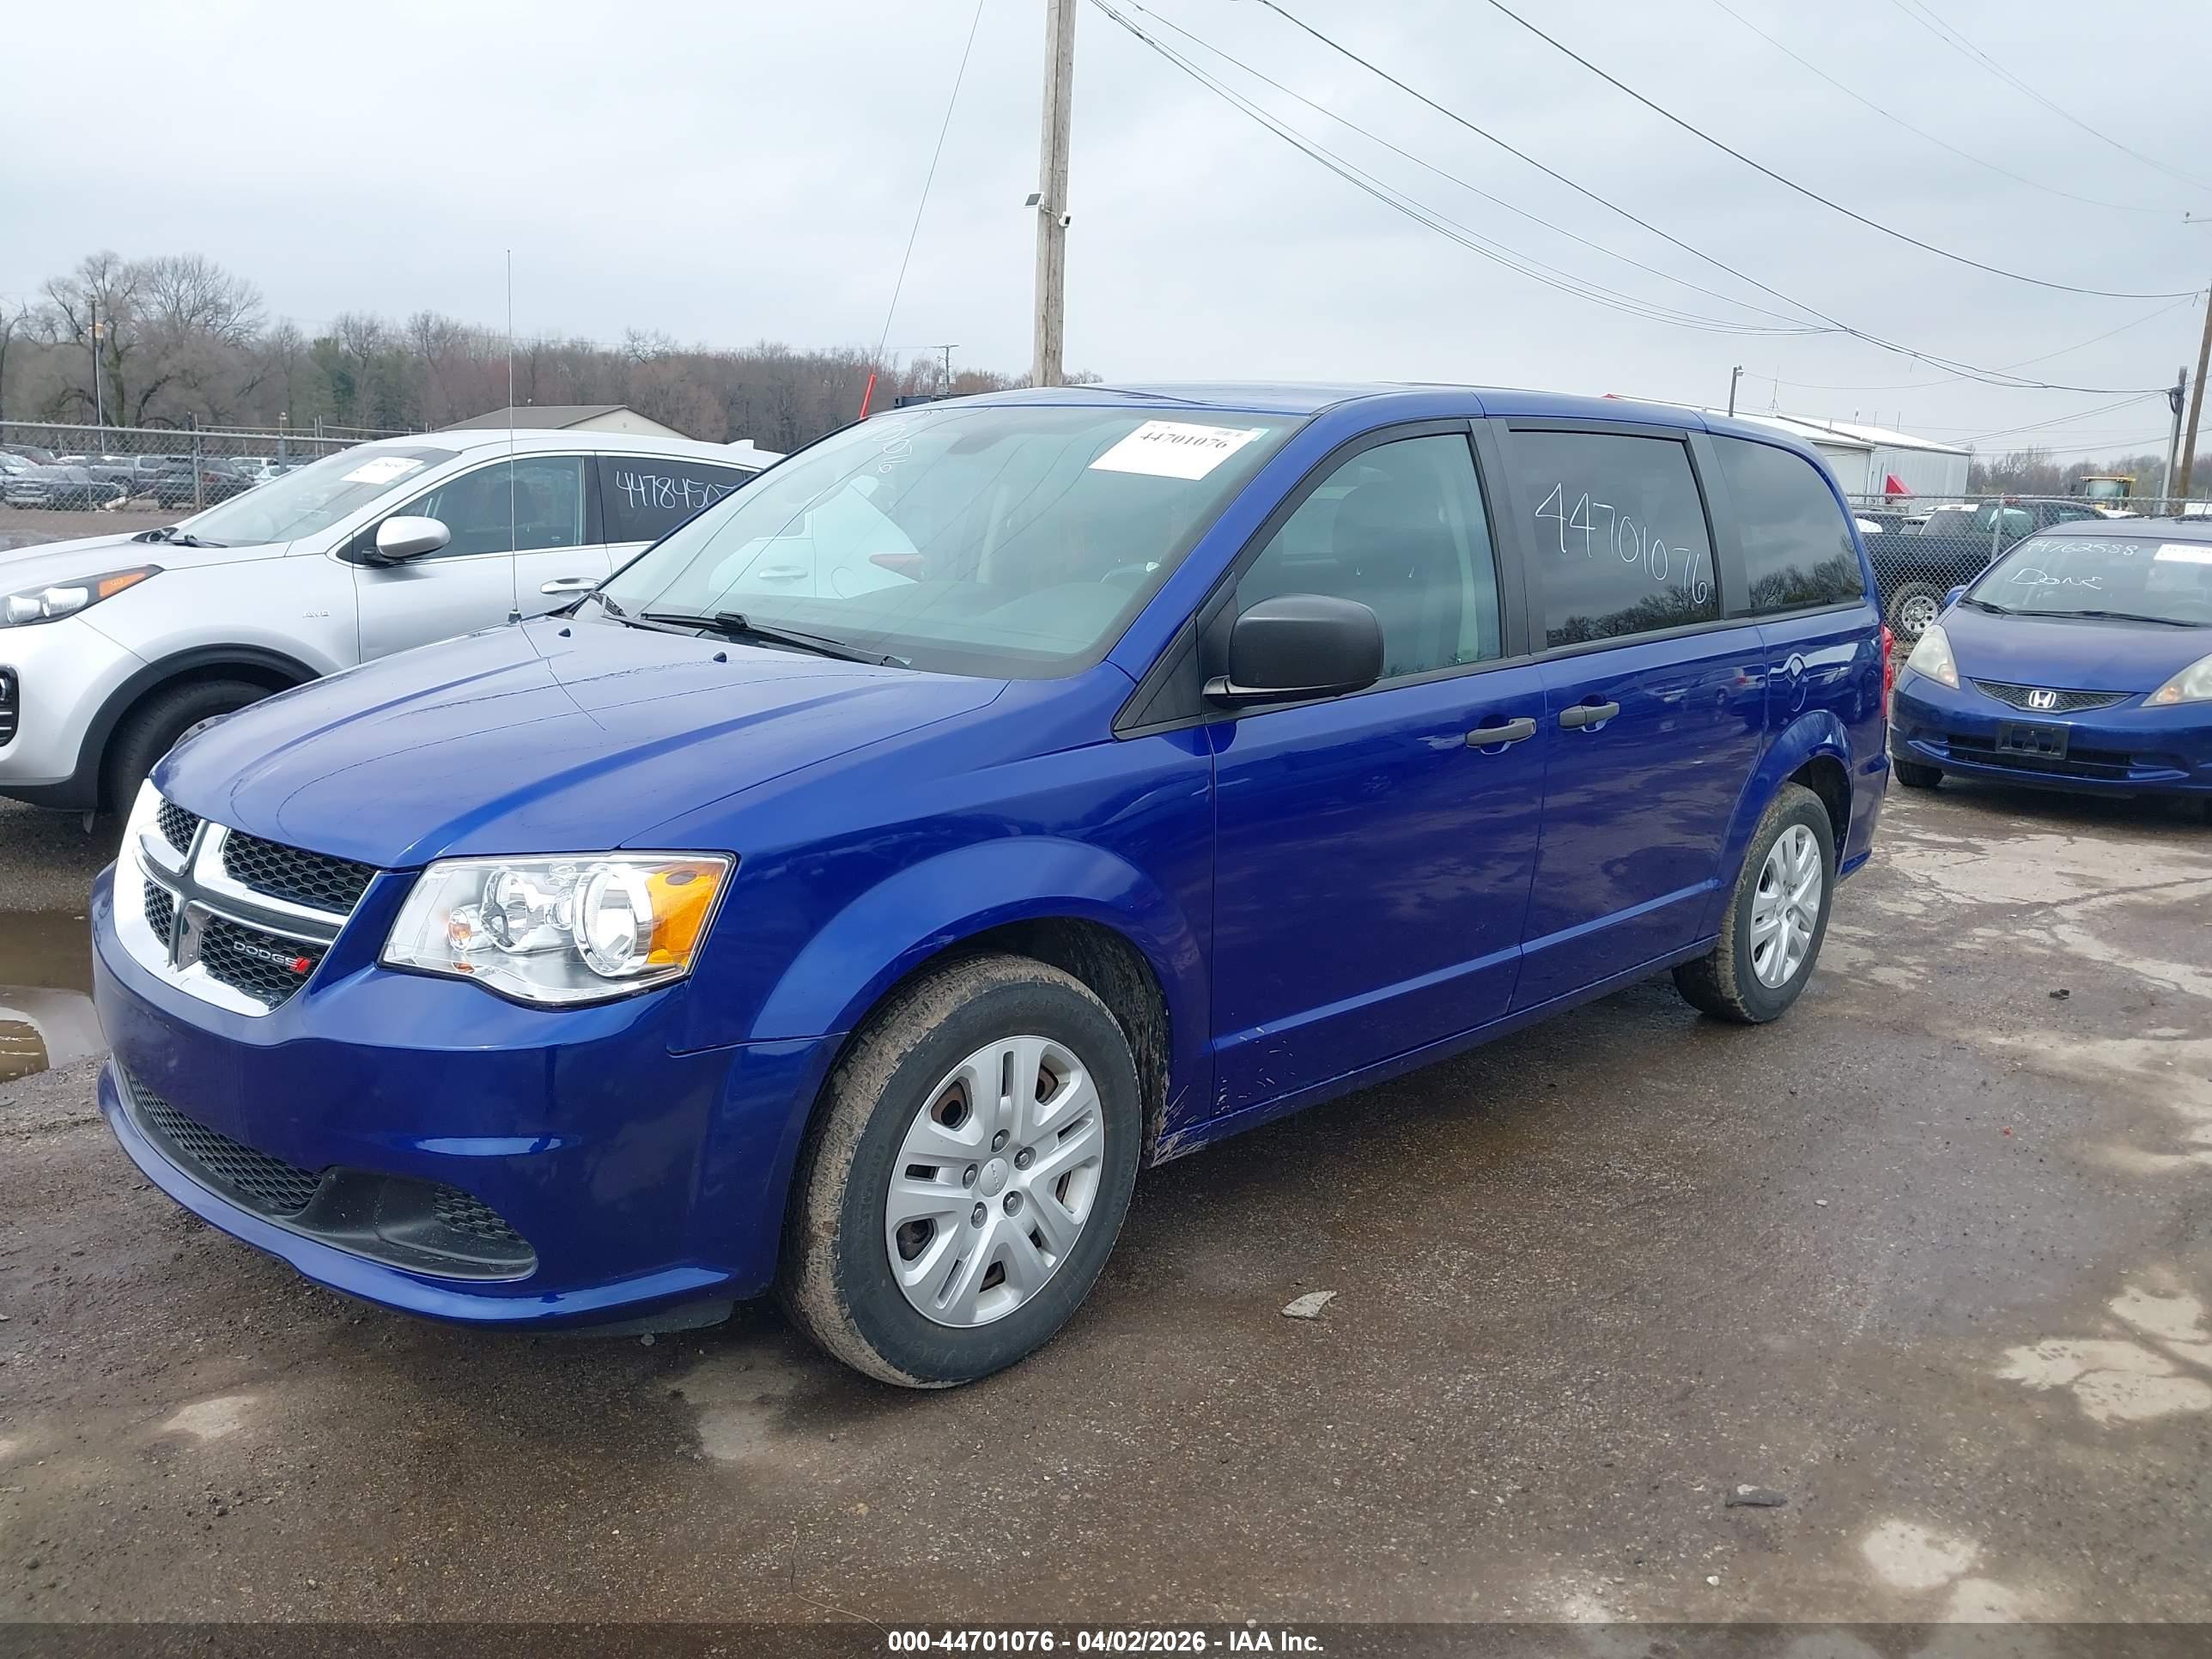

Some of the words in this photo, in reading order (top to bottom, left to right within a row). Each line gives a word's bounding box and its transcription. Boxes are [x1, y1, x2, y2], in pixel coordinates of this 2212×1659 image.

[1139, 431, 1230, 449] 44701076
[1534, 481, 1708, 604] 44701076
[233, 940, 298, 968] DODGE
